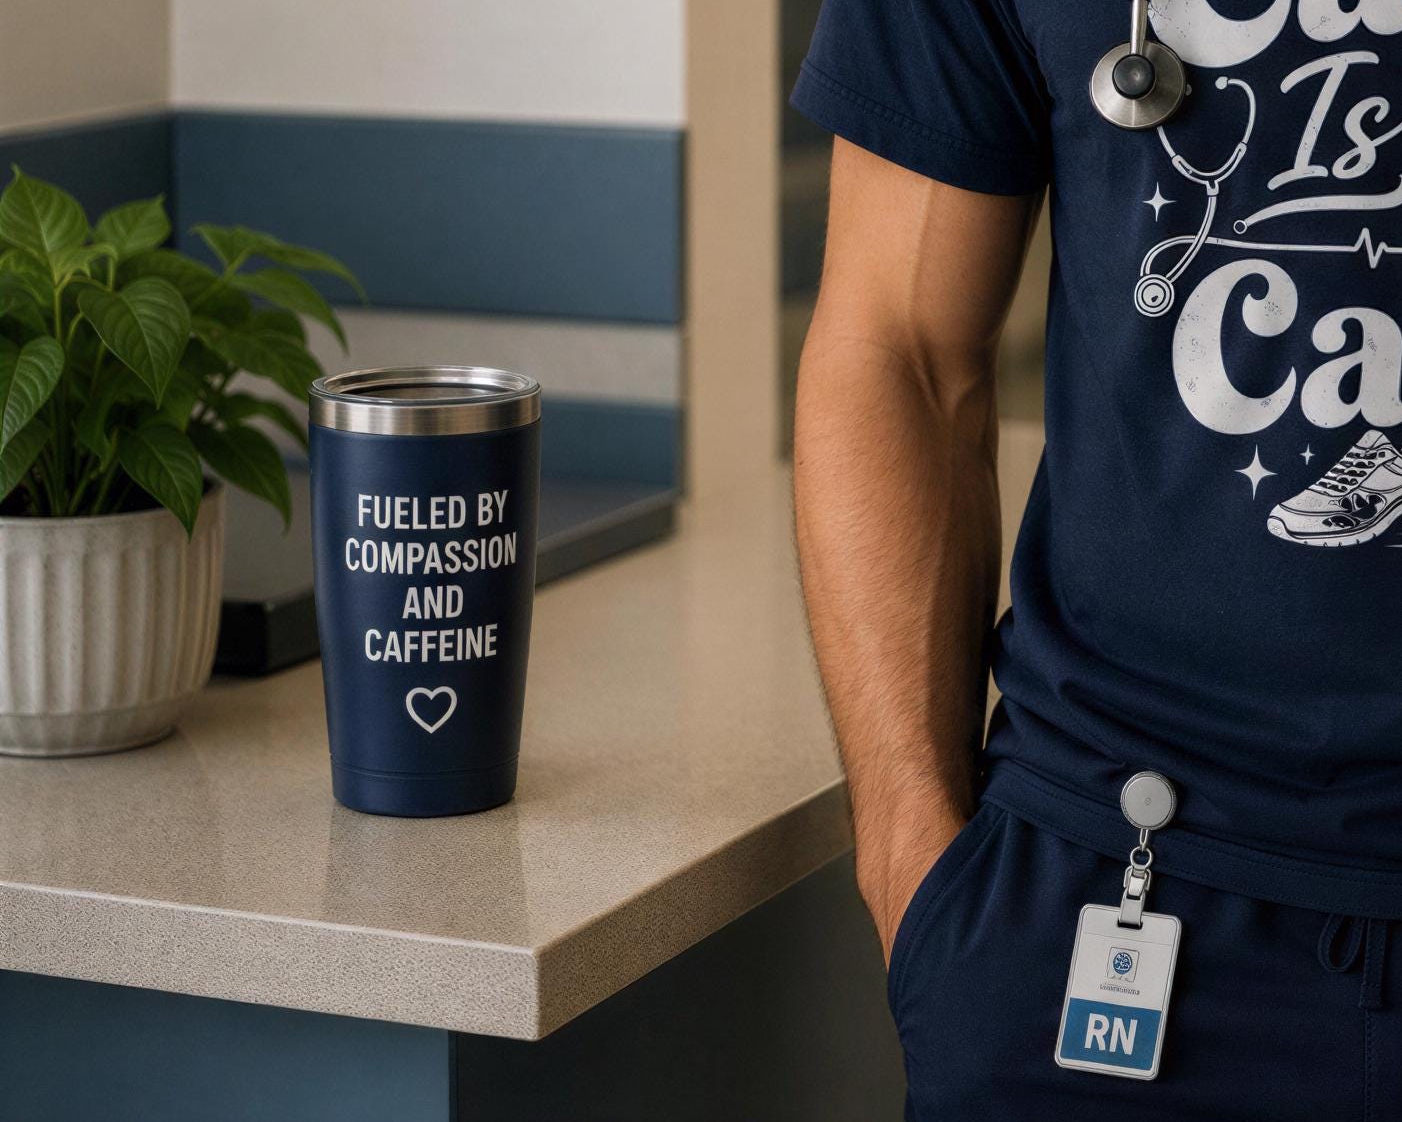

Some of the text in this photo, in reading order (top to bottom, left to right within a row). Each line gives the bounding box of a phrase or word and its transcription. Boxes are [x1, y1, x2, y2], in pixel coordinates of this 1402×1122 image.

[357, 489, 509, 530] FUELED BY
[345, 532, 517, 575] COMPASSION
[401, 584, 464, 620] AND
[364, 623, 498, 663] CAFFEINE
[1083, 1012, 1139, 1056] RN
